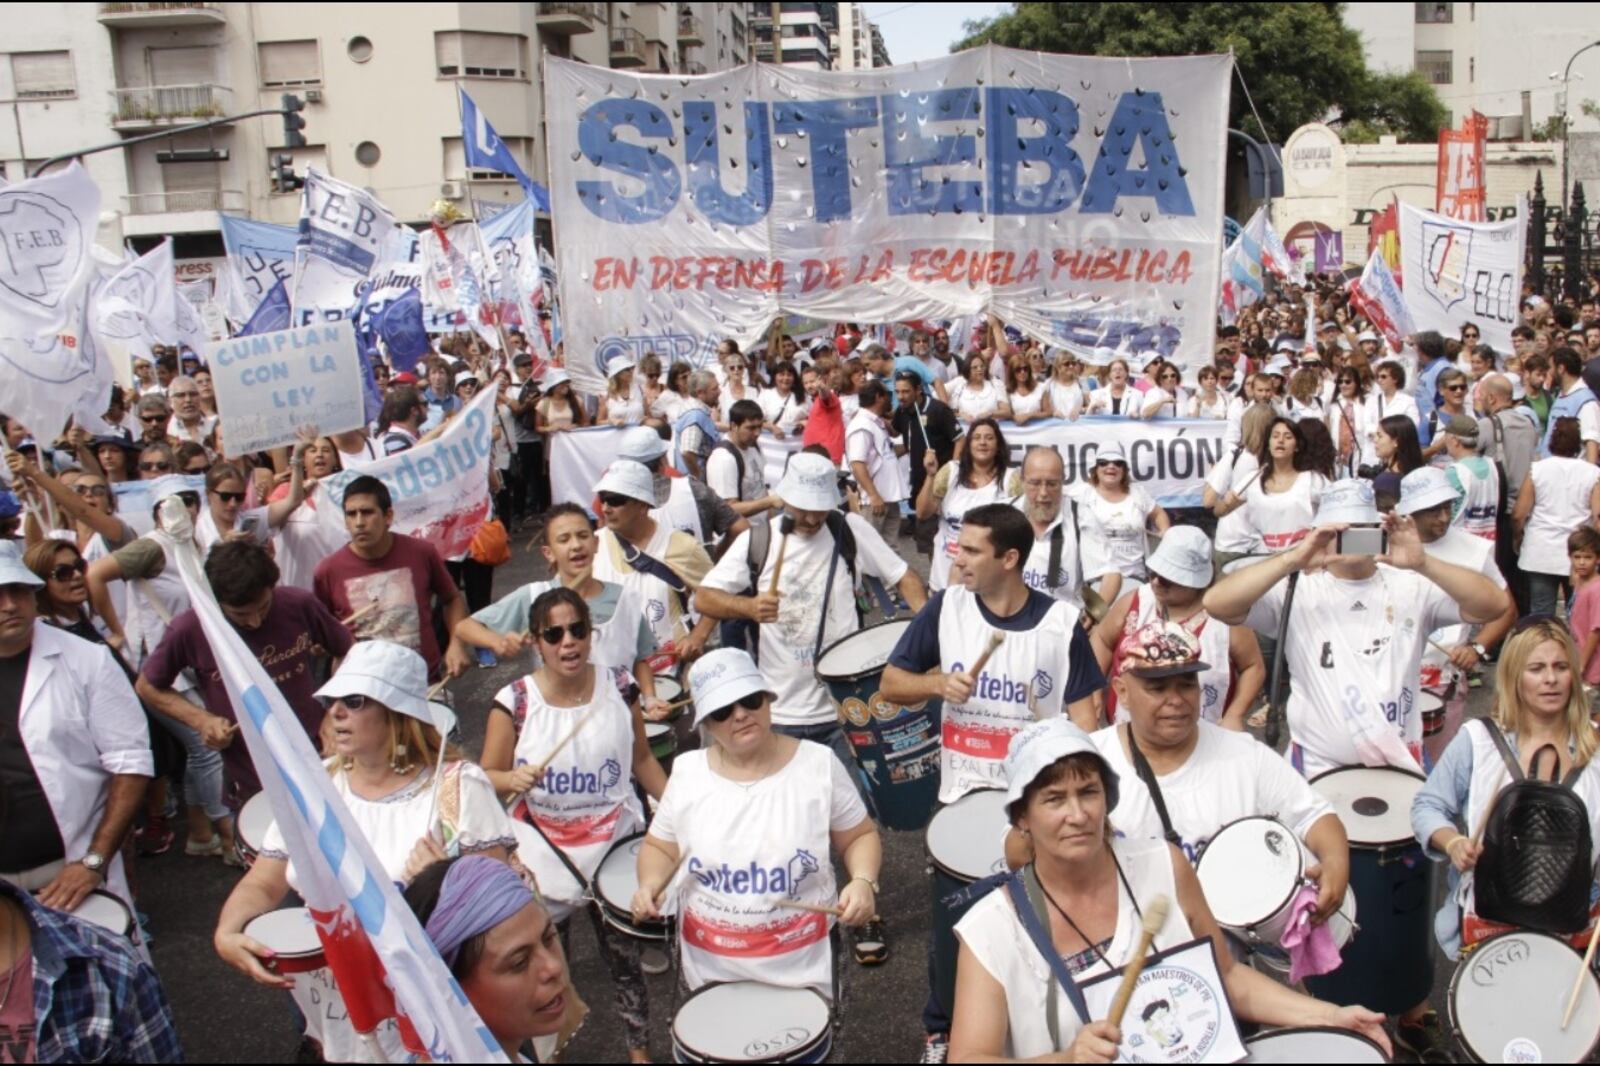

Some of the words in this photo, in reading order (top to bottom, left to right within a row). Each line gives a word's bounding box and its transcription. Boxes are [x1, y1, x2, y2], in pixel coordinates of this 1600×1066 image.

[575, 86, 1196, 226] SUTEBA
[591, 257, 638, 291] EN
[649, 255, 787, 292] DEFENSA
[799, 258, 850, 292] DE
[853, 250, 894, 285] LA
[906, 248, 1040, 288] ESCUELA
[216, 327, 340, 367] CUMPLAN
[240, 361, 289, 386] CON
[309, 354, 336, 373] LA
[272, 386, 315, 408] LEY
[950, 662, 1028, 704] teba
[688, 856, 787, 895] Suteba
[1478, 943, 1523, 979] VSG
